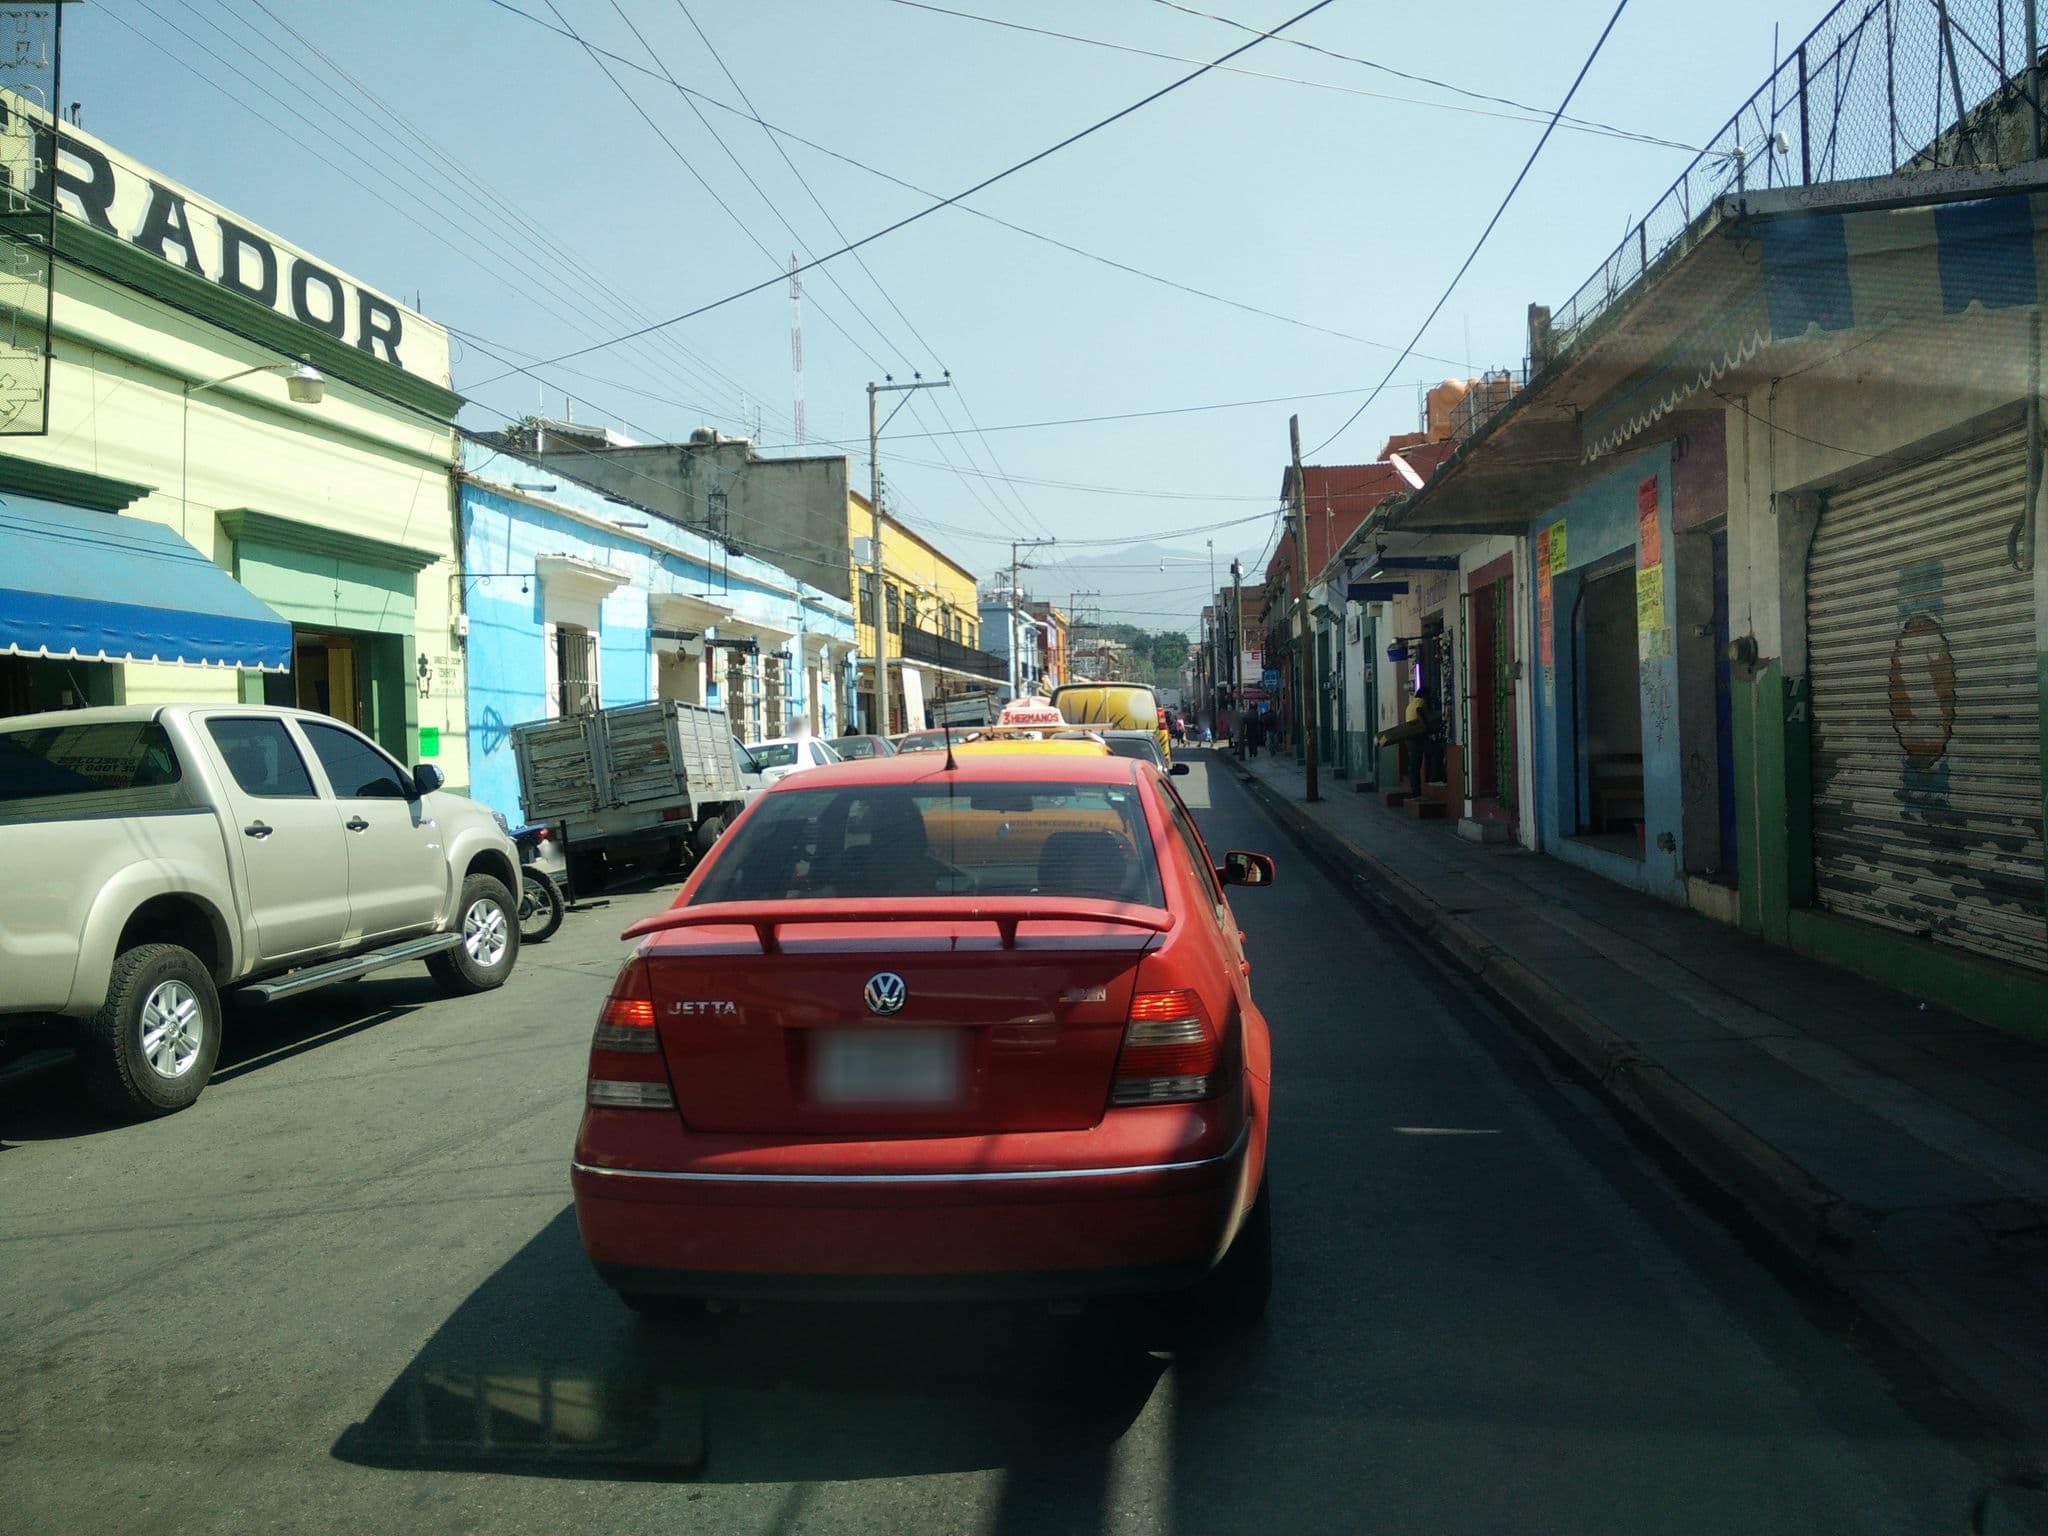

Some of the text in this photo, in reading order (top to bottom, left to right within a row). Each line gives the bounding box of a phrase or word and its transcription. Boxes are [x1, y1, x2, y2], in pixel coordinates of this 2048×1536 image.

[0, 98, 403, 368] RADOR
[1011, 712, 1059, 723] HERMANOS
[667, 1001, 737, 1015] JETTA
